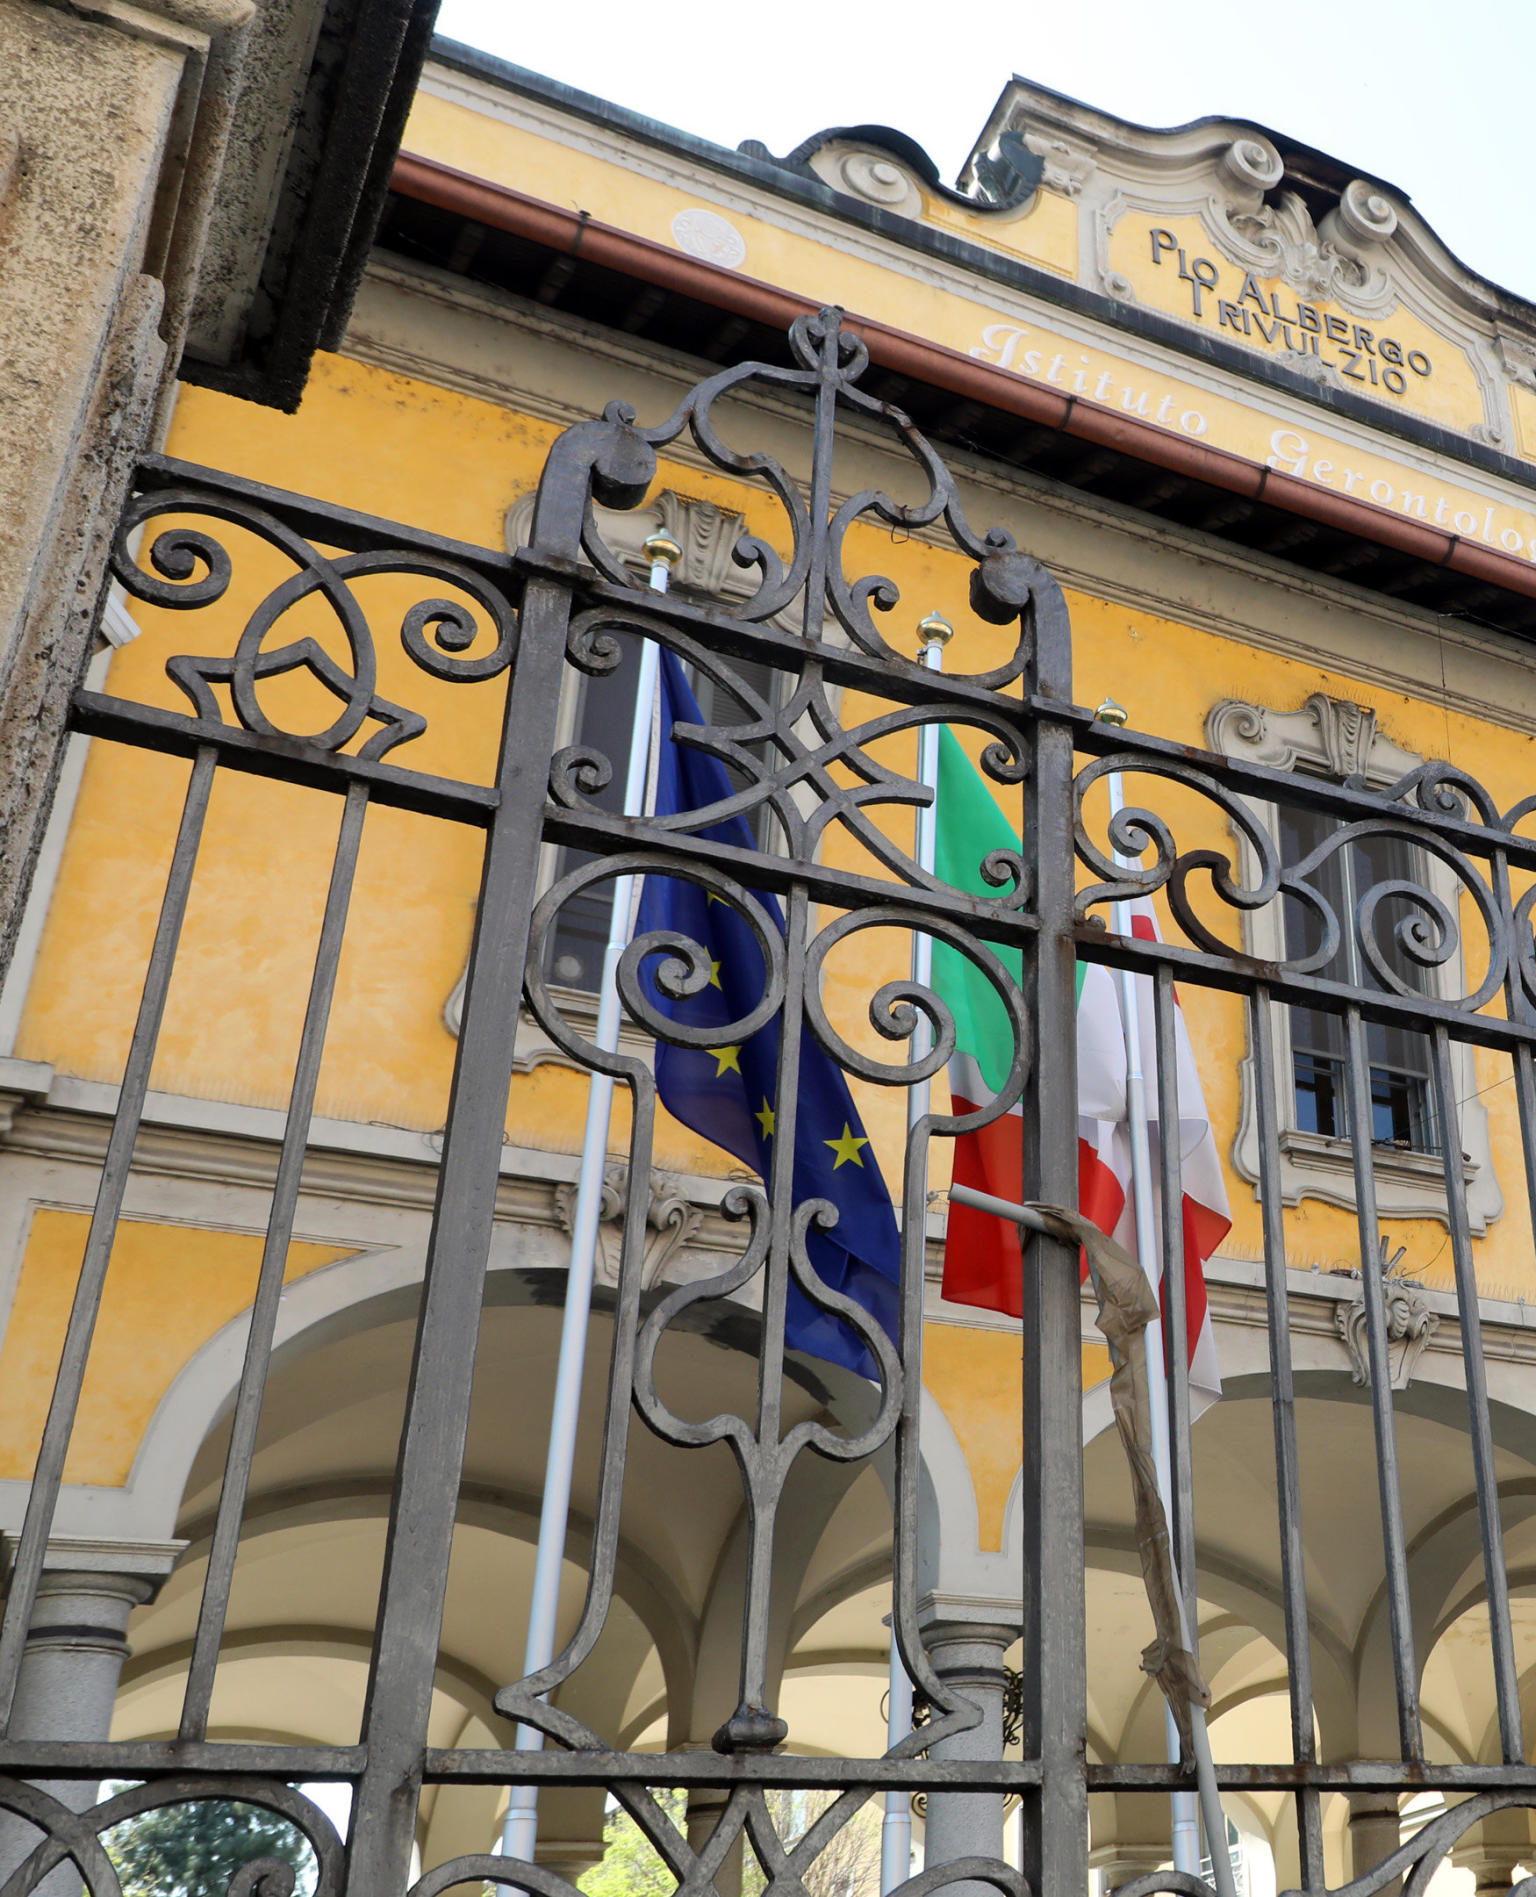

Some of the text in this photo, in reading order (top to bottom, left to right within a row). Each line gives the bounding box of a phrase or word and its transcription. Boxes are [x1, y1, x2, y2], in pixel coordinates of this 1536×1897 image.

[1150, 228, 1433, 376] PIO ALBERGO
[1179, 273, 1408, 394] TRIVULZIO
[968, 324, 1208, 437] Istituto
